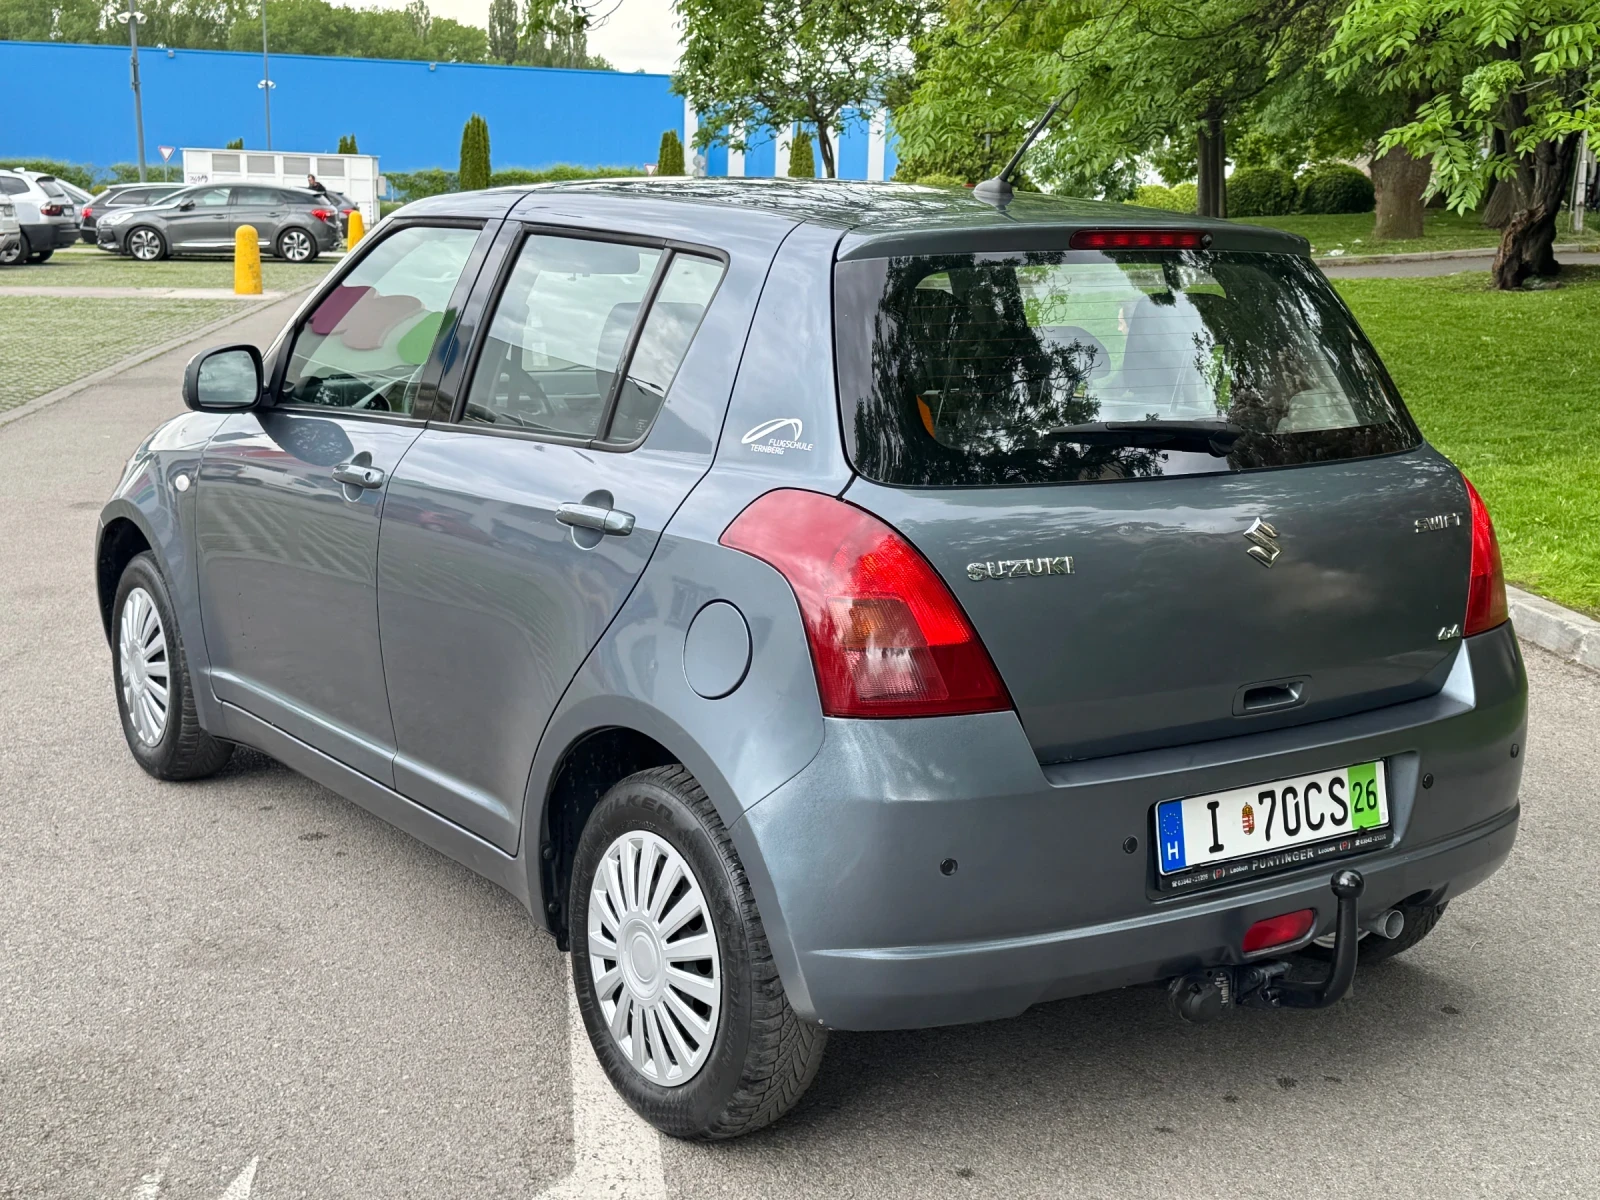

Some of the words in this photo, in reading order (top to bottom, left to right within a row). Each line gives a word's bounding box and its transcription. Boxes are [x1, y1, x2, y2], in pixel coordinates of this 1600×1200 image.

[750, 443, 785, 455] TERNBERG
[768, 438, 813, 451] FLUGSCHULE
[1414, 512, 1463, 533] SWIFT
[966, 556, 1075, 581] SUZUKI
[1352, 779, 1378, 814] 26
[1206, 801, 1225, 854] I
[1258, 777, 1349, 842] 70CS
[1167, 841, 1179, 861] H
[1252, 848, 1315, 871] PUNTINGER
